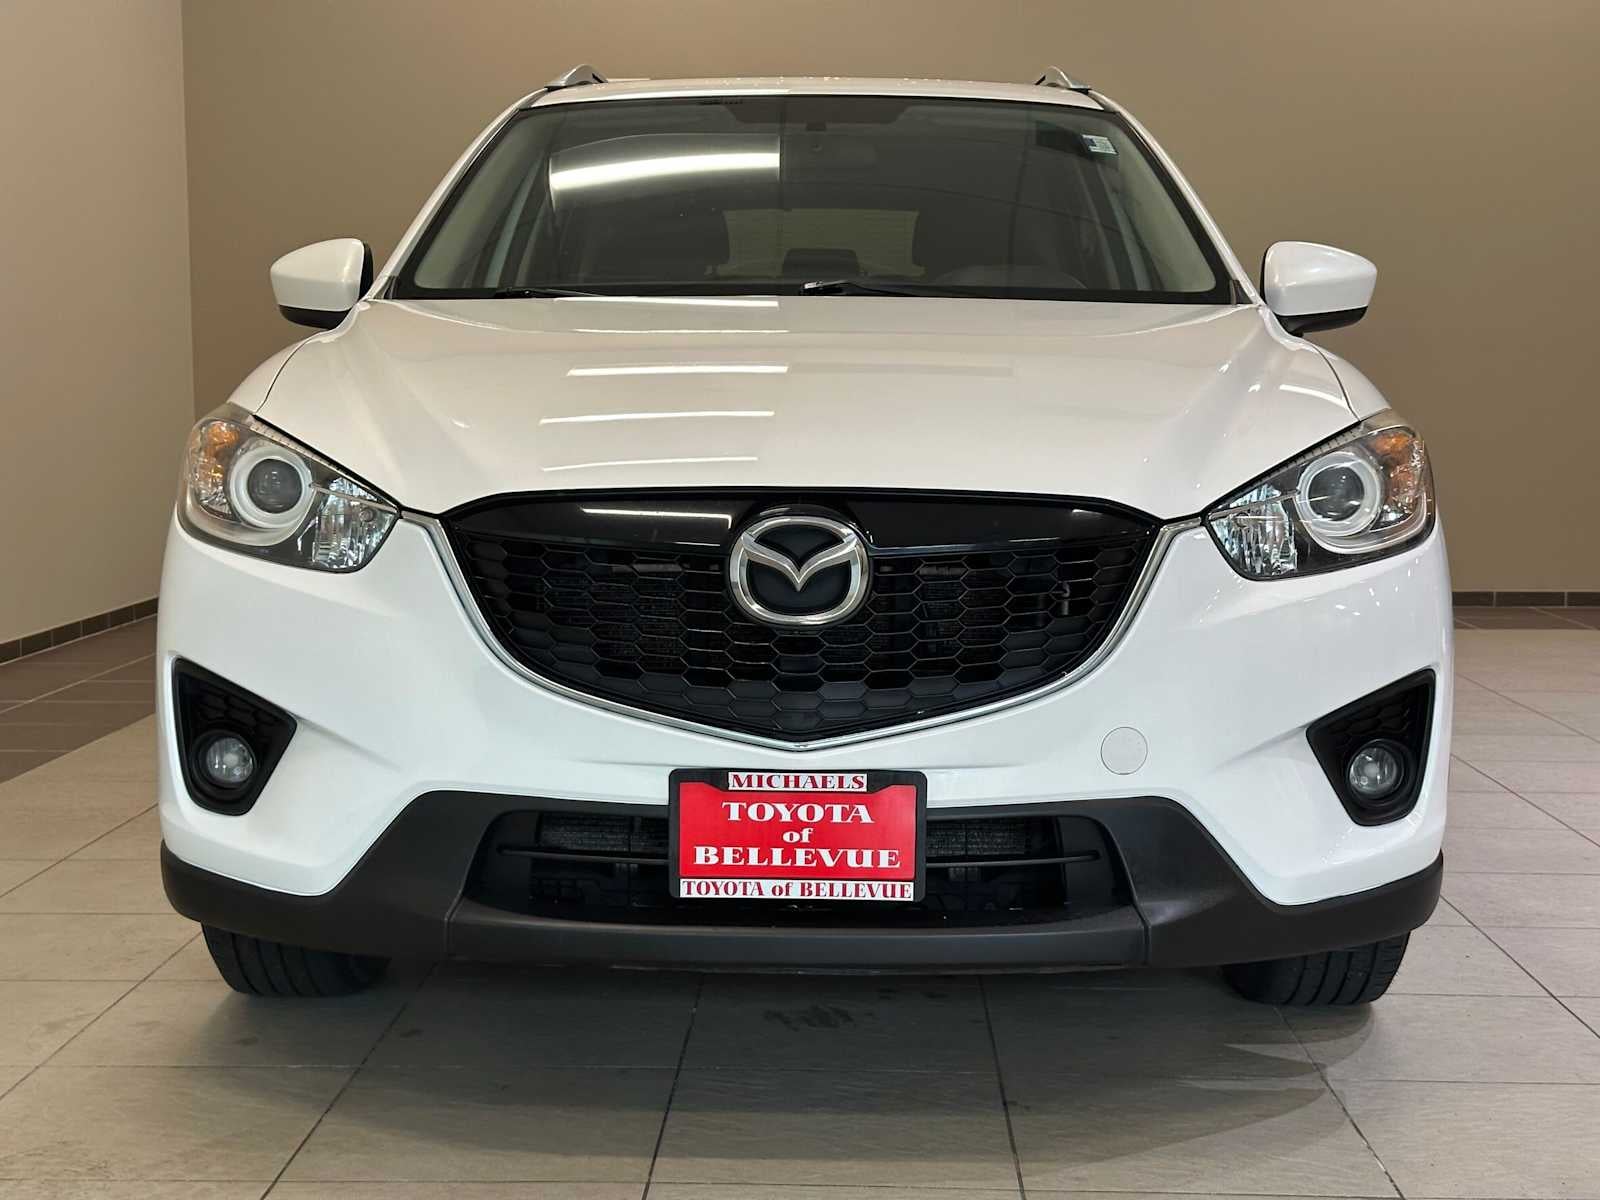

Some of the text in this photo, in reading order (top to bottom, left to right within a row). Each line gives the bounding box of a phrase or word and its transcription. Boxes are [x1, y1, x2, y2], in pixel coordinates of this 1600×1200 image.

[731, 774, 865, 789] MICHAELS
[722, 801, 875, 823] TOYOTA
[782, 828, 814, 843] of
[693, 846, 900, 868] BELLEVUE
[682, 880, 912, 899] TOYOTA of BELLEVUE
